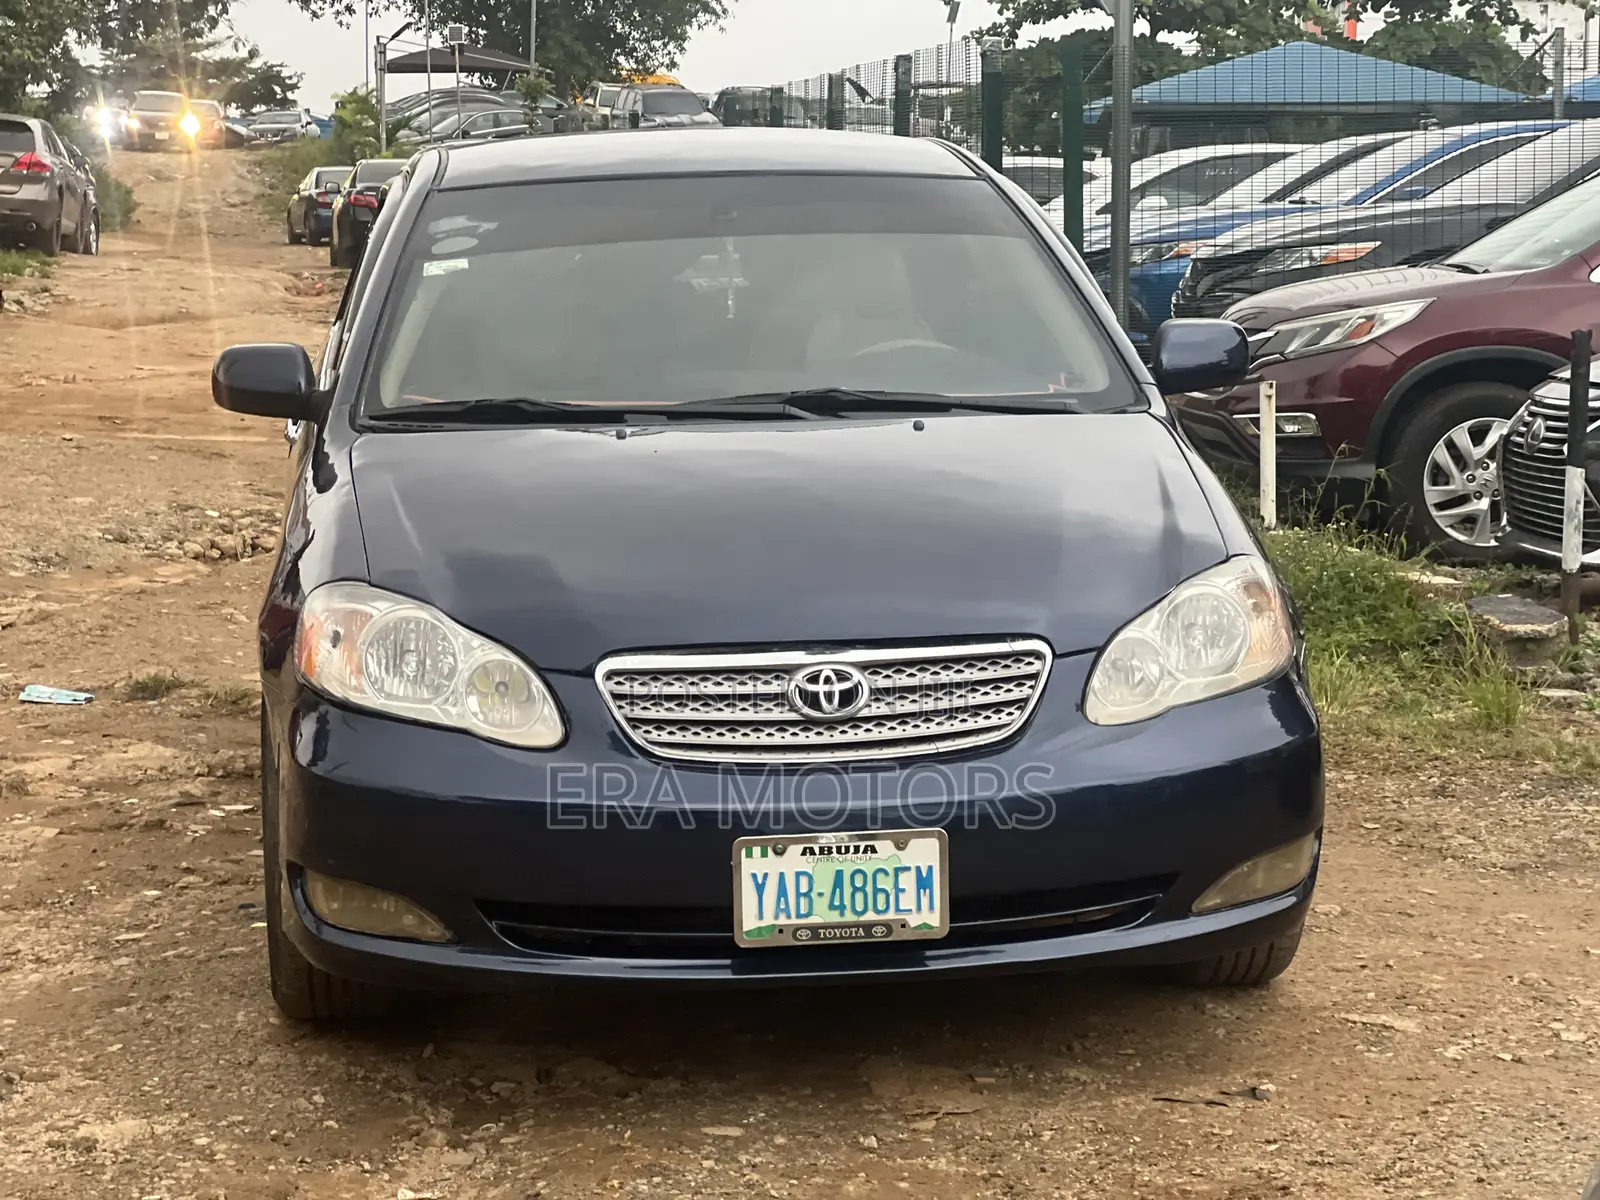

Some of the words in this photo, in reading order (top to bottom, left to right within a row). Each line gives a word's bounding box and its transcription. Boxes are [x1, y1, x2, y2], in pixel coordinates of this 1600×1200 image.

[800, 844, 878, 856] ABUJA
[805, 856, 835, 864] CENTRE
[837, 855, 849, 863] OF
[751, 865, 935, 921] YAB-486EM
[818, 928, 865, 938] TOYOTA
